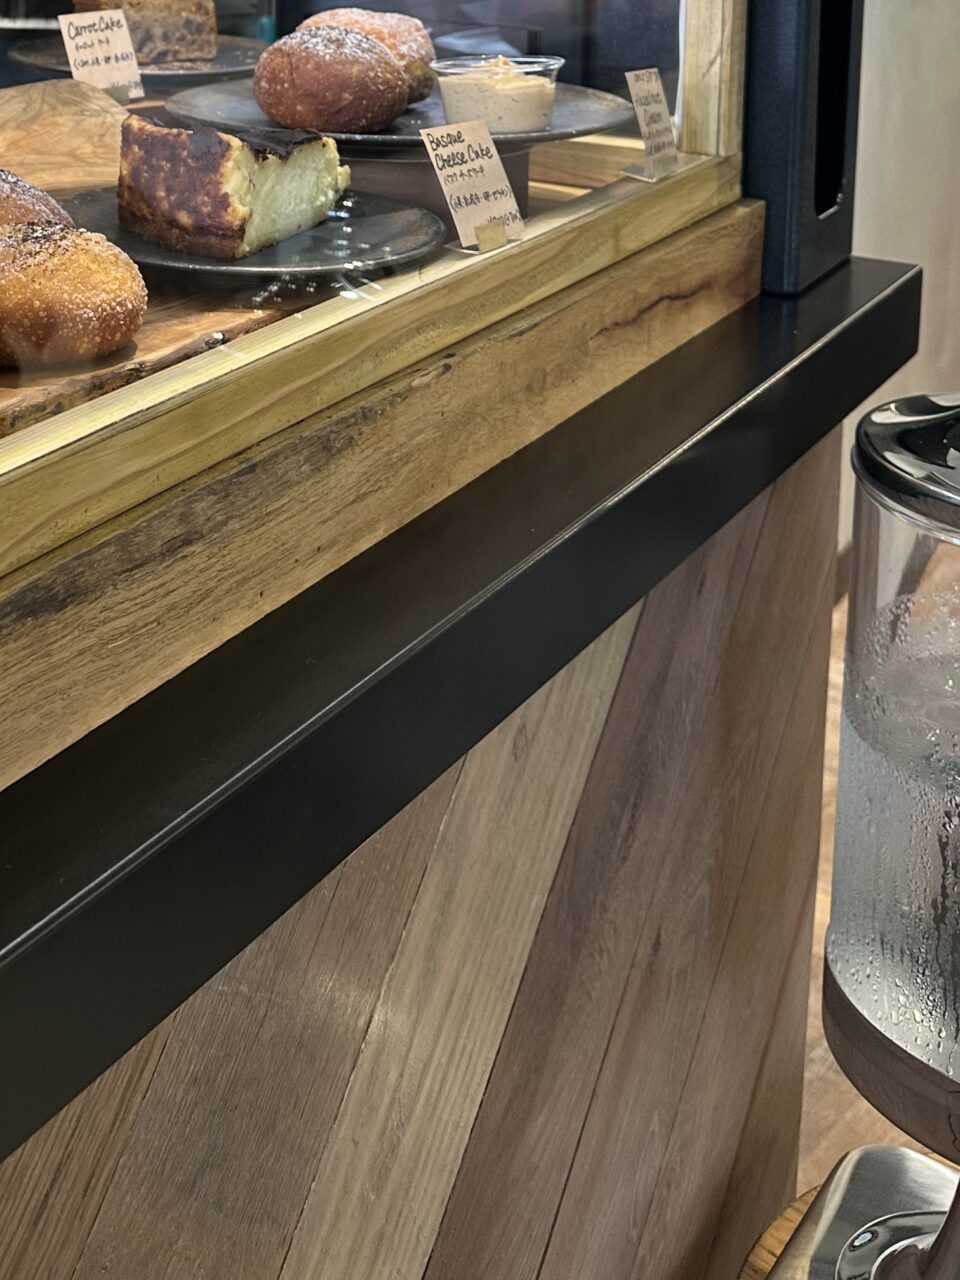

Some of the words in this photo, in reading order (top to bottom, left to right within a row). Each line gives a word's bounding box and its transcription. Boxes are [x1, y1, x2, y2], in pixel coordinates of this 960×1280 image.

[99, 16, 123, 32] Cake
[427, 130, 465, 152] Basque
[434, 151, 468, 171] Cheese
[467, 143, 493, 162] Cake
